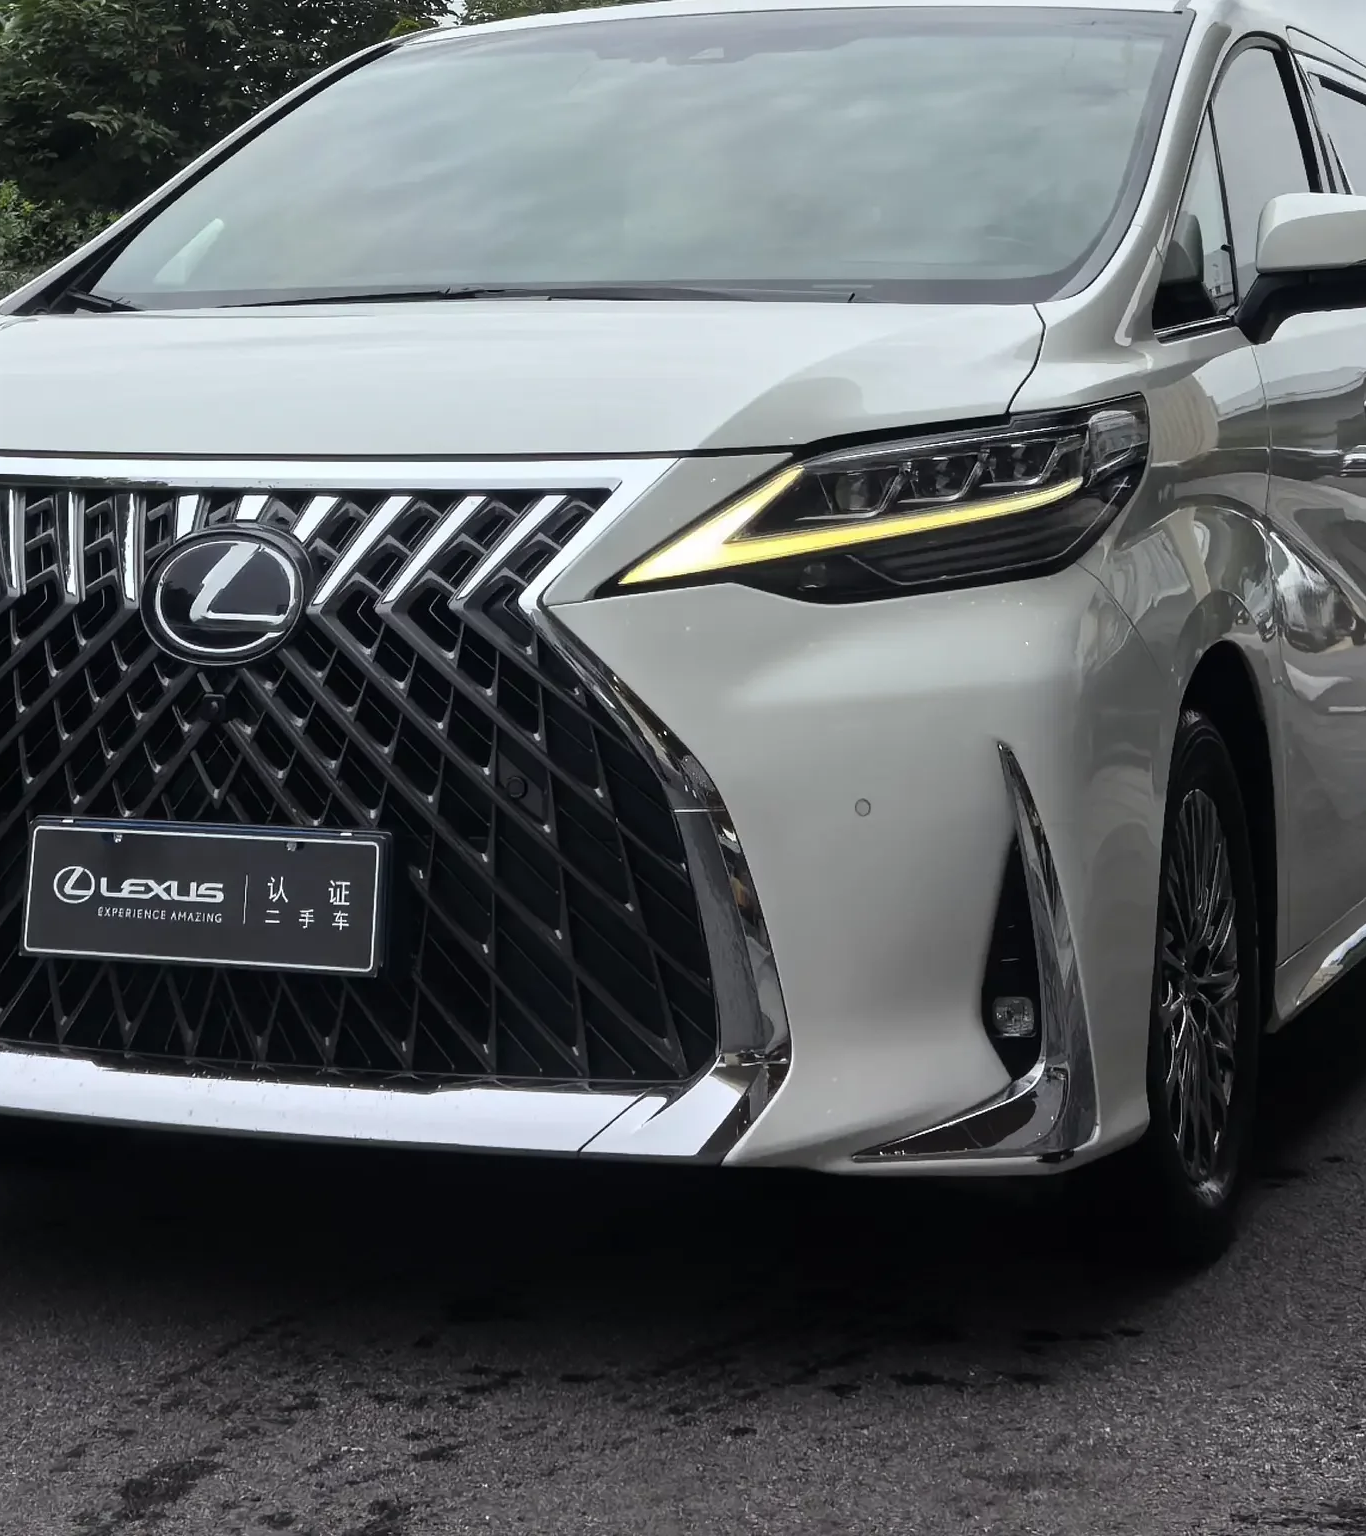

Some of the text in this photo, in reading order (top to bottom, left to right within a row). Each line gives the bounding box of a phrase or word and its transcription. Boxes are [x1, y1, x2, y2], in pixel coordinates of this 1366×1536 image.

[100, 876, 225, 904] LEXUS
[97, 906, 223, 924] EXPERIENCE AMAZING
[264, 909, 350, 931] 二手车
